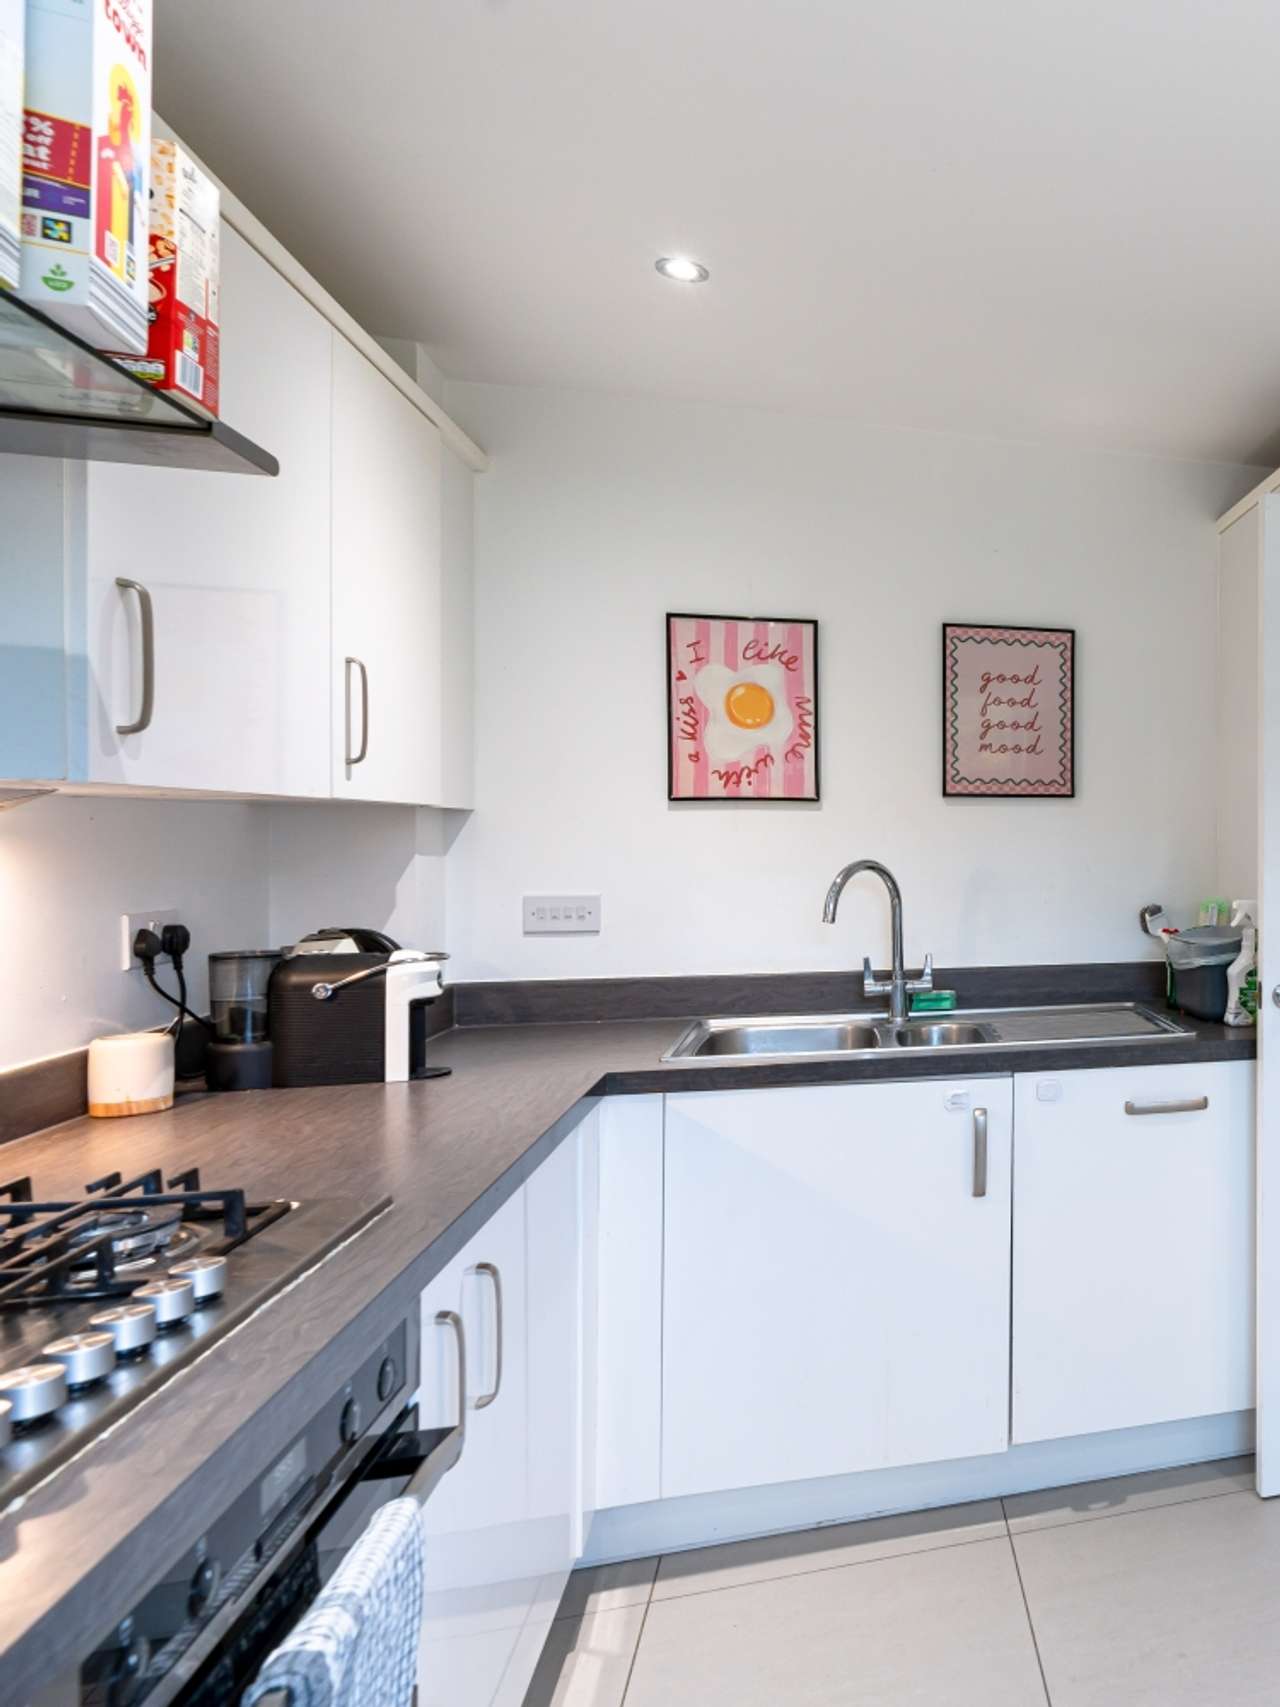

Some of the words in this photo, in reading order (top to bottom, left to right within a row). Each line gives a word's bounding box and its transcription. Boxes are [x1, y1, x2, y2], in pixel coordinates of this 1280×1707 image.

[742, 638, 800, 672] like
[979, 664, 1042, 694] good
[979, 687, 1039, 717] food
[979, 711, 1042, 740] good
[978, 734, 1044, 755] mood
[711, 753, 774, 789] with
